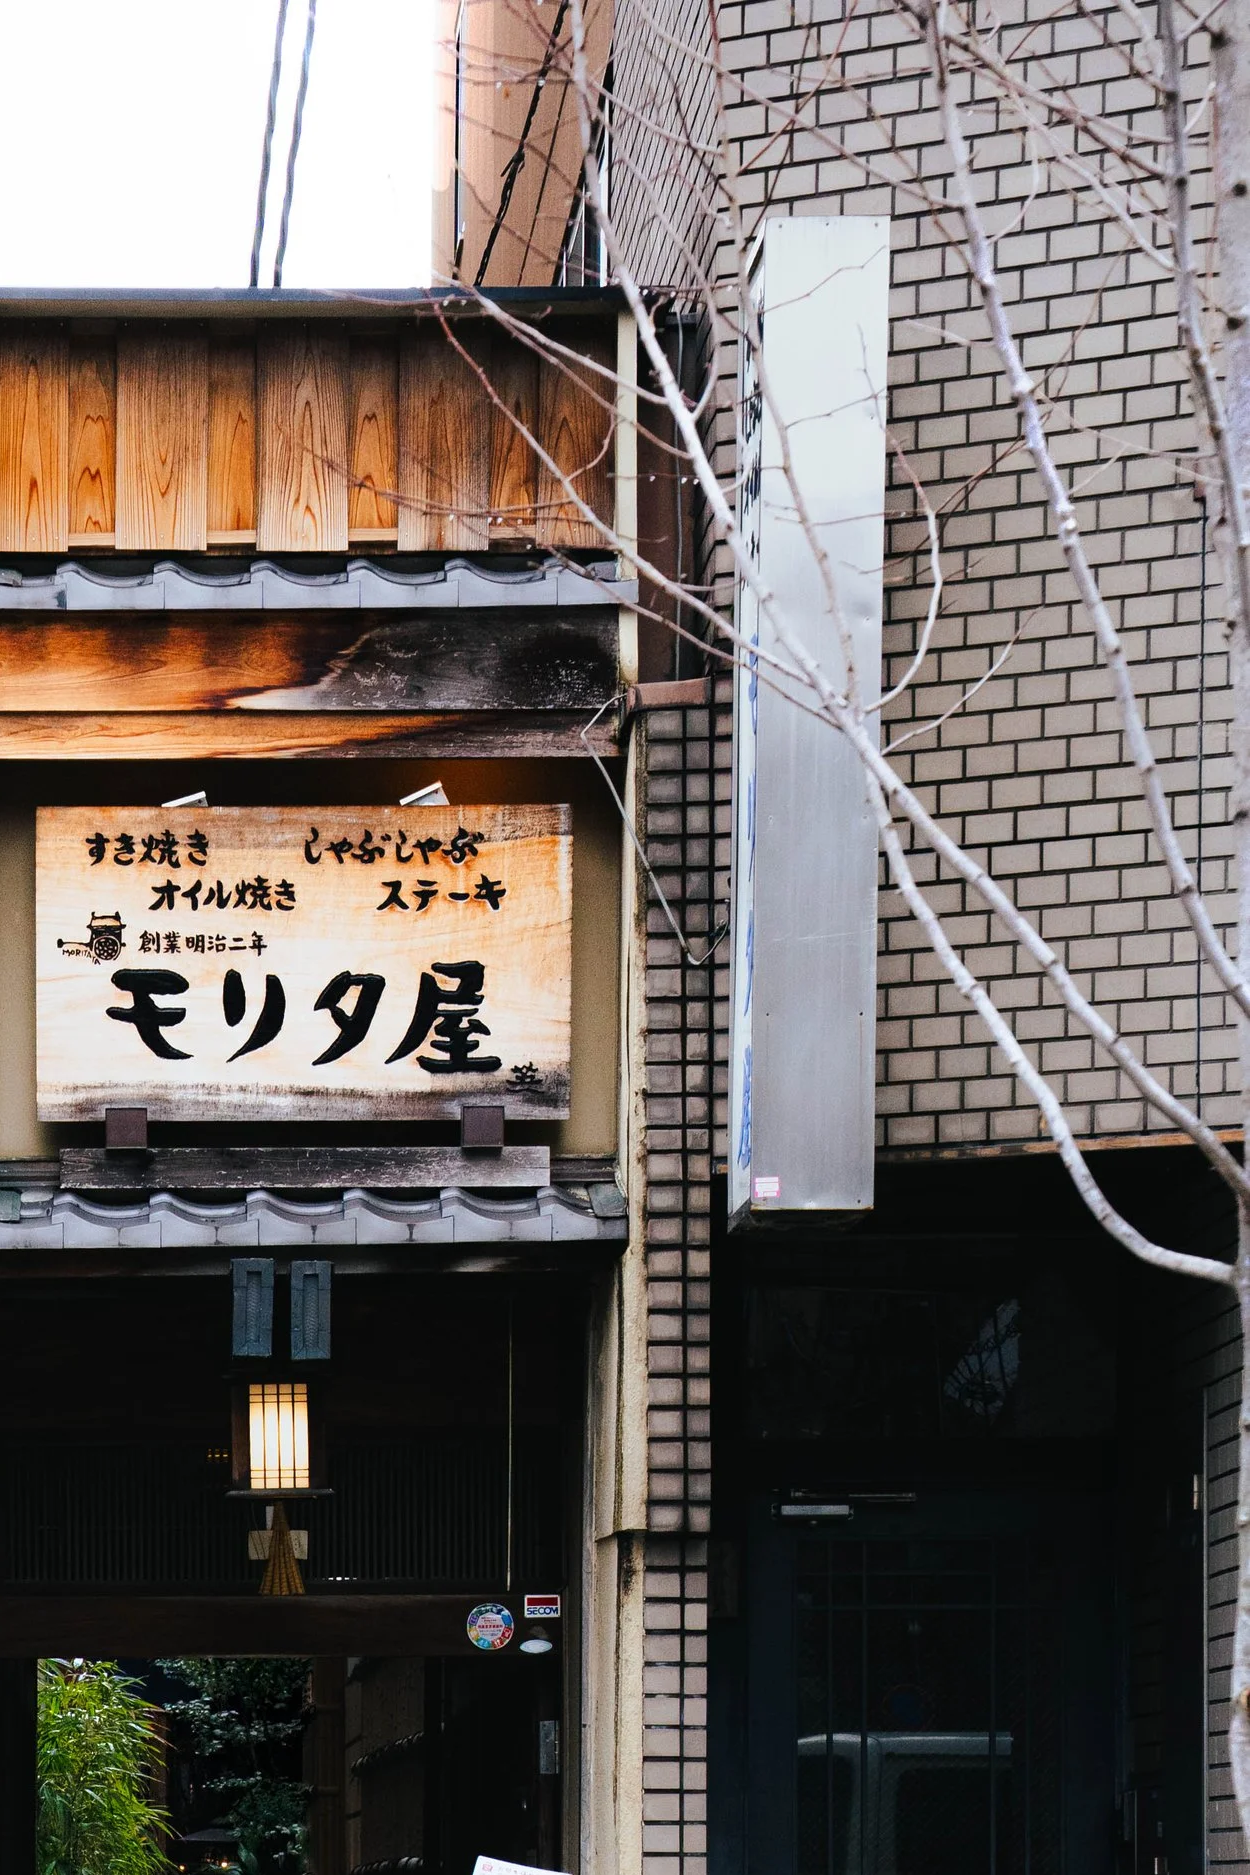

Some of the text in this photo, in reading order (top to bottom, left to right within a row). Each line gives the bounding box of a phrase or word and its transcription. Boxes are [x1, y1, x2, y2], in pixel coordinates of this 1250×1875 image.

[84, 829, 210, 868] すき焼き
[304, 826, 485, 866] しゃぶしゃぶ
[148, 875, 297, 912] オイル焼き
[376, 873, 508, 912] ステーキ
[138, 930, 268, 957] 創業明治二年
[106, 960, 502, 1074] モリタ屋
[526, 1606, 559, 1616] SECOM
